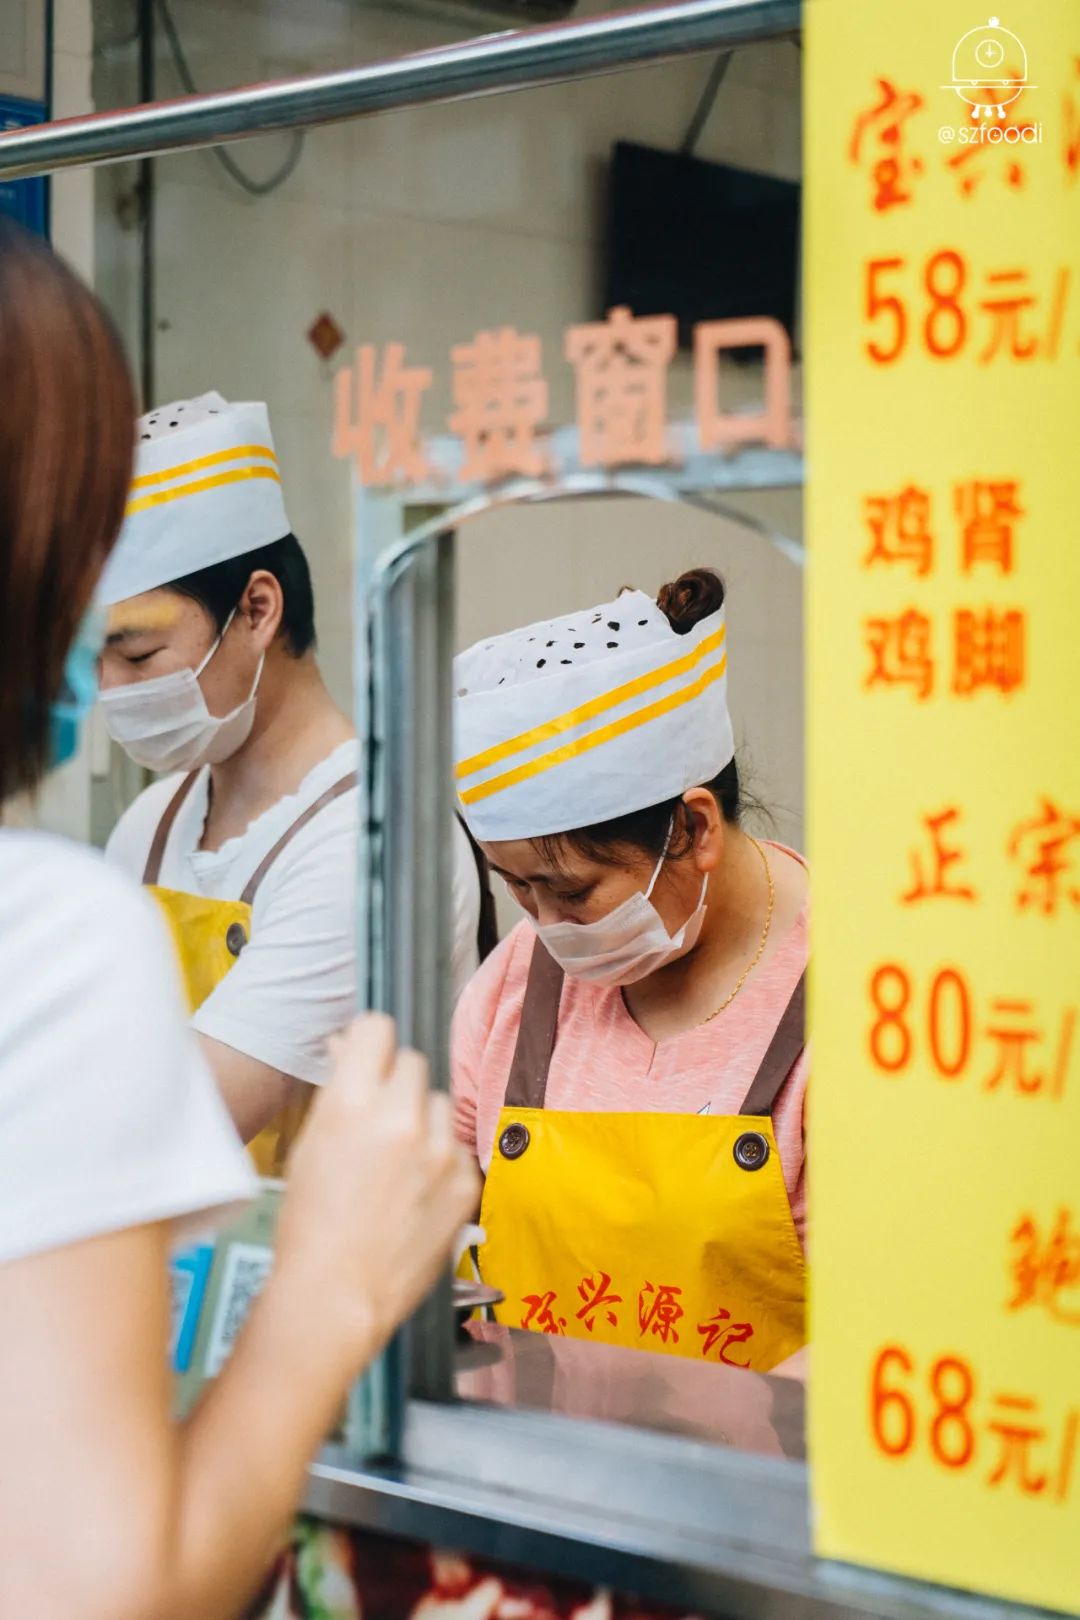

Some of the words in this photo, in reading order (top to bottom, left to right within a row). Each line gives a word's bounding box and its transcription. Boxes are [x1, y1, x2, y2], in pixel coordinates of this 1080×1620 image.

[847, 55, 1080, 213] 宝兴
[332, 305, 791, 486] 收费窗口
[862, 478, 1025, 578] 鸡肾
[862, 605, 1026, 702] 鸡脚
